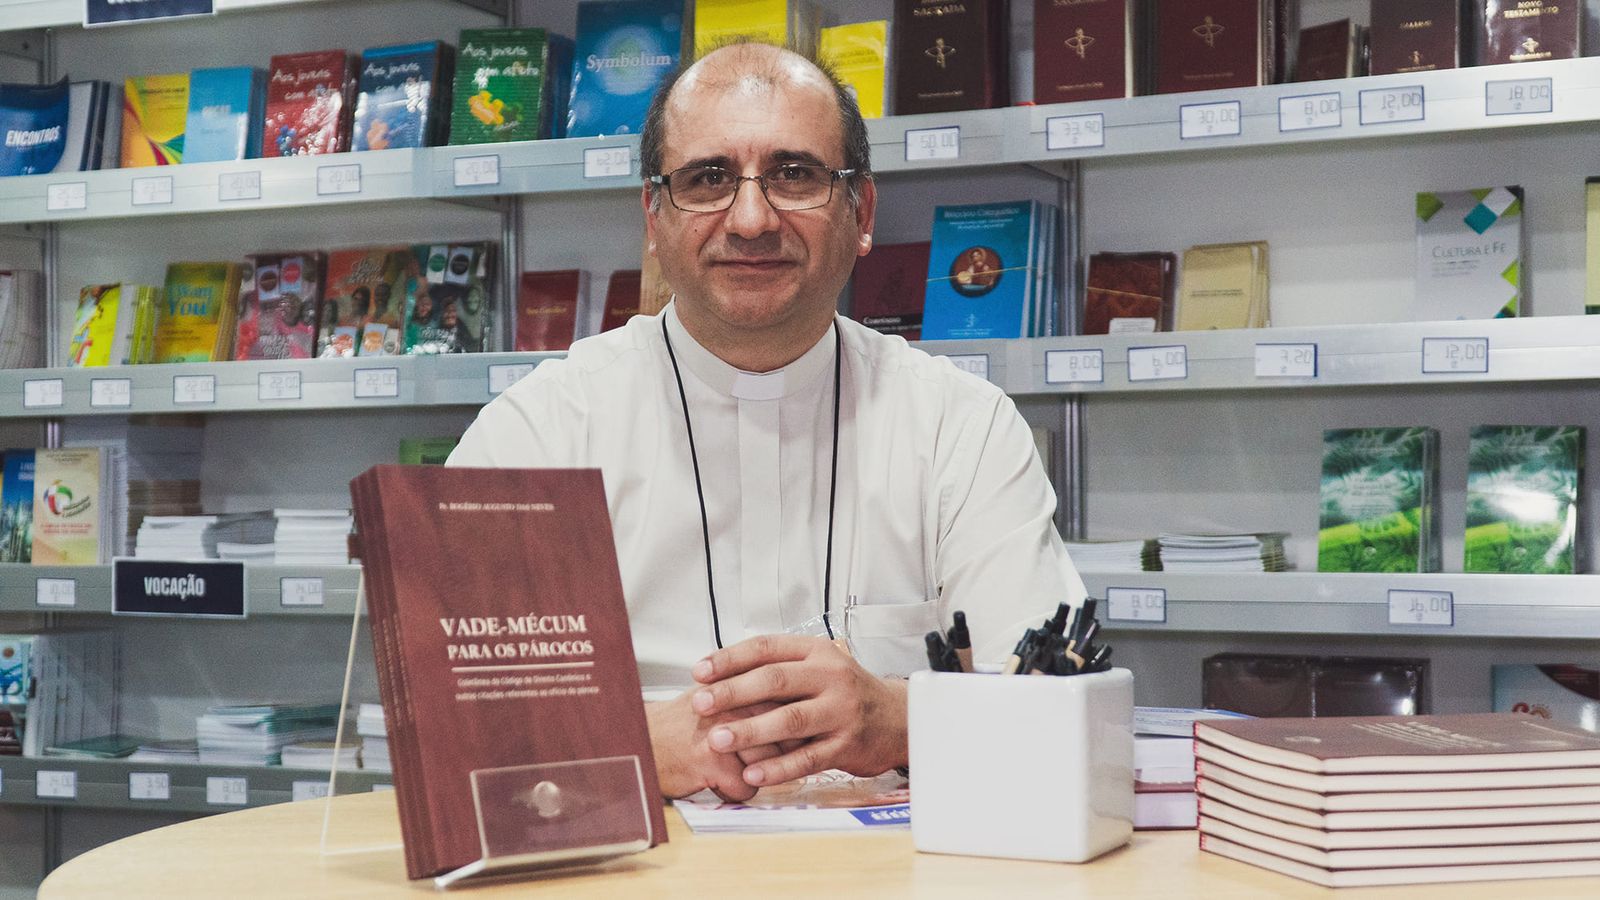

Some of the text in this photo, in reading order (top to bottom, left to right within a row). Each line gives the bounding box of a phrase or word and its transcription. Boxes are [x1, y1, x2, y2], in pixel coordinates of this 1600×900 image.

[1517, 1, 1543, 9] NOVO
[463, 43, 528, 60] Aos jovens
[364, 63, 386, 76] Aos
[586, 54, 671, 72] Symbolum
[272, 69, 295, 82] Aos
[5, 126, 61, 147] ENCONTROS
[143, 573, 205, 600] VOCAÇÃO
[440, 612, 587, 637] VADE-MÉCUM
[447, 639, 594, 660] PARA OS PÁROCOS
[501, 676, 523, 686] Código
